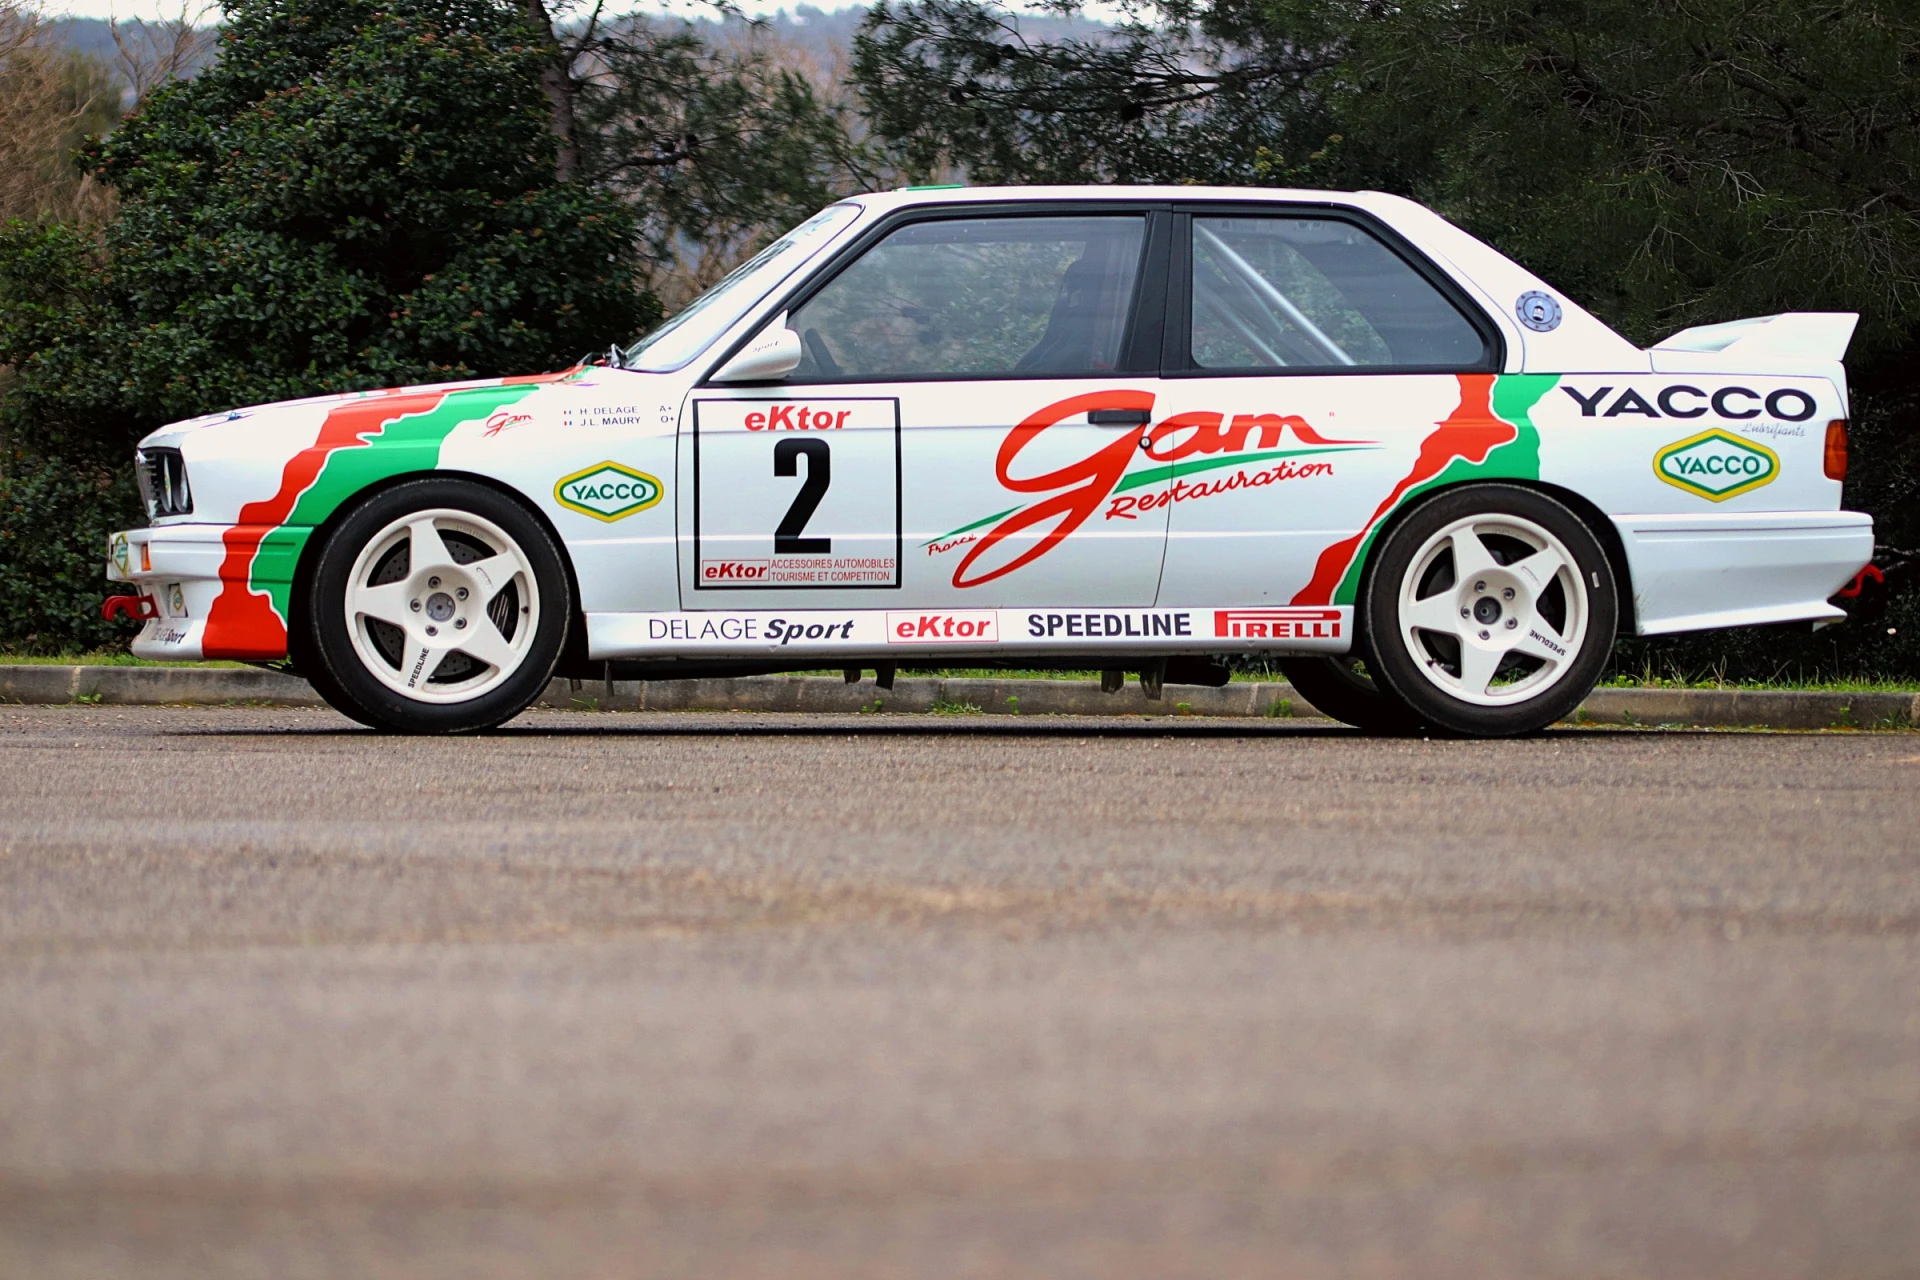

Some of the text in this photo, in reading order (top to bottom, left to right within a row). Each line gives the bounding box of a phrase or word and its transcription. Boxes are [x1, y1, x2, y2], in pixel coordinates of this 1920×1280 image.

[594, 406, 638, 415] DELAGE
[659, 405, 673, 413] A+
[1559, 384, 1817, 422] YACCO
[602, 416, 641, 426] MAURY
[660, 415, 675, 424] O+
[744, 405, 852, 432] eKtor
[1673, 455, 1761, 475] YACCO
[572, 483, 647, 501] YACCO
[774, 437, 832, 555] 2
[1105, 460, 1334, 521] Restauration
[928, 533, 977, 556] France
[705, 563, 768, 579] eKtor
[771, 558, 895, 569] ACCESSOIRES AUTOMOBILES
[771, 571, 890, 582] TOURISME ET COMPETITION
[649, 618, 854, 645] DELAGE Sport
[896, 615, 991, 638] eKtor
[1027, 613, 1192, 637] SPEEDLINE
[1213, 610, 1343, 638] PIRELLI
[1529, 629, 1567, 657] SPEEDLINE
[408, 647, 430, 689] SPEEDLINE
